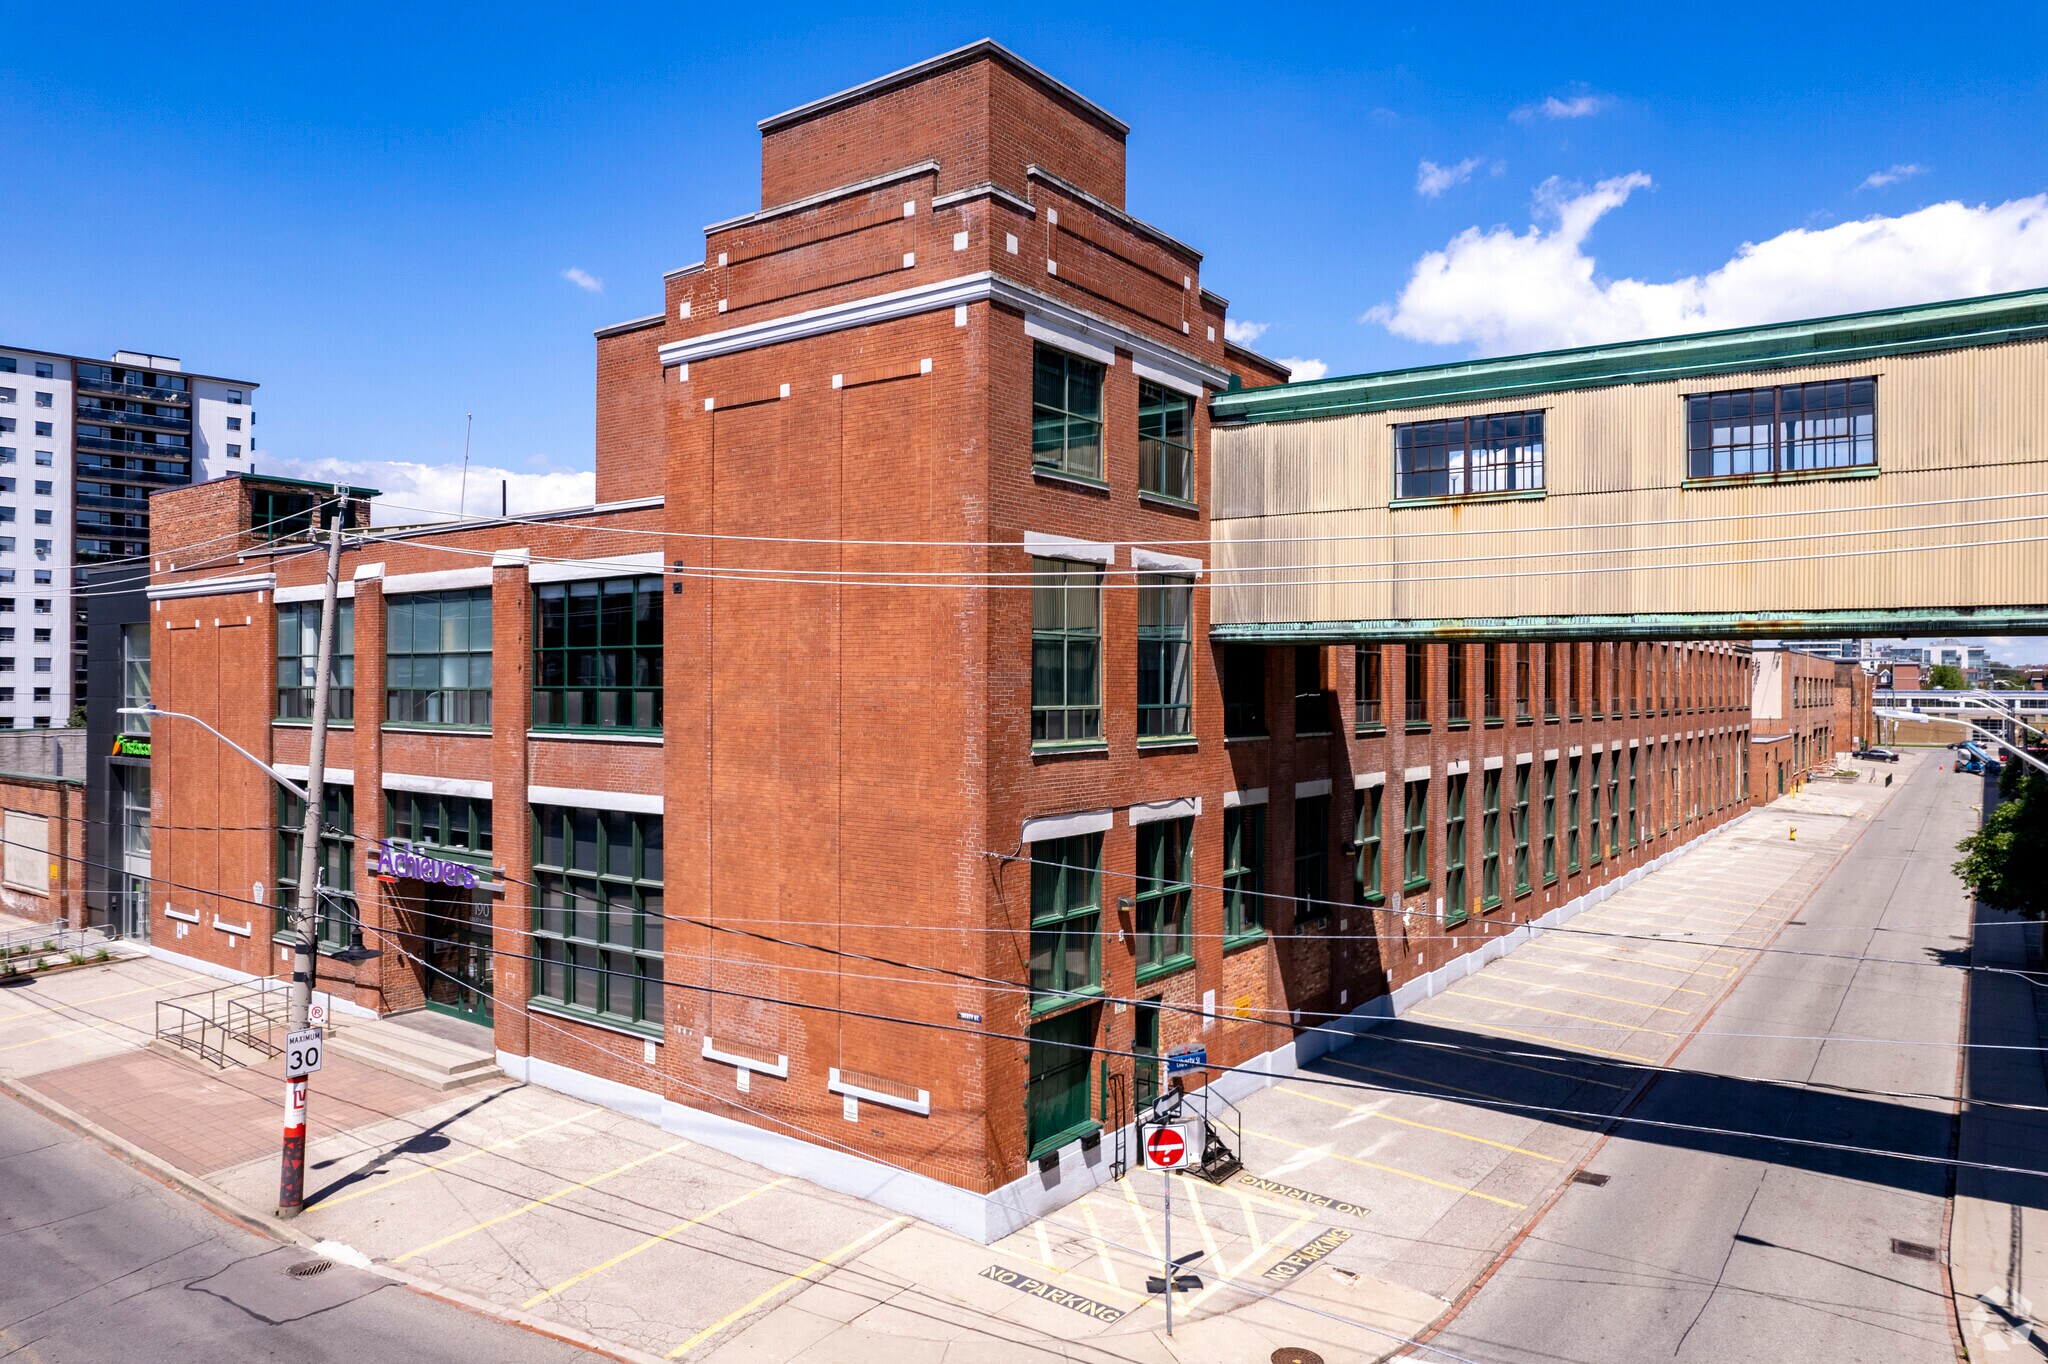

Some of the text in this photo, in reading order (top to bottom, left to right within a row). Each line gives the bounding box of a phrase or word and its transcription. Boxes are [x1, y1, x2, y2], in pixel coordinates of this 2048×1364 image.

[377, 838, 475, 889] Achievers
[474, 902, 490, 917] 190
[289, 1033, 320, 1045] MAXIMUM
[290, 1047, 319, 1070] 30
[1240, 1175, 1370, 1218] NO PARKING
[1263, 1227, 1351, 1282] NO PARKING
[980, 1266, 1120, 1322] NO PARKING
